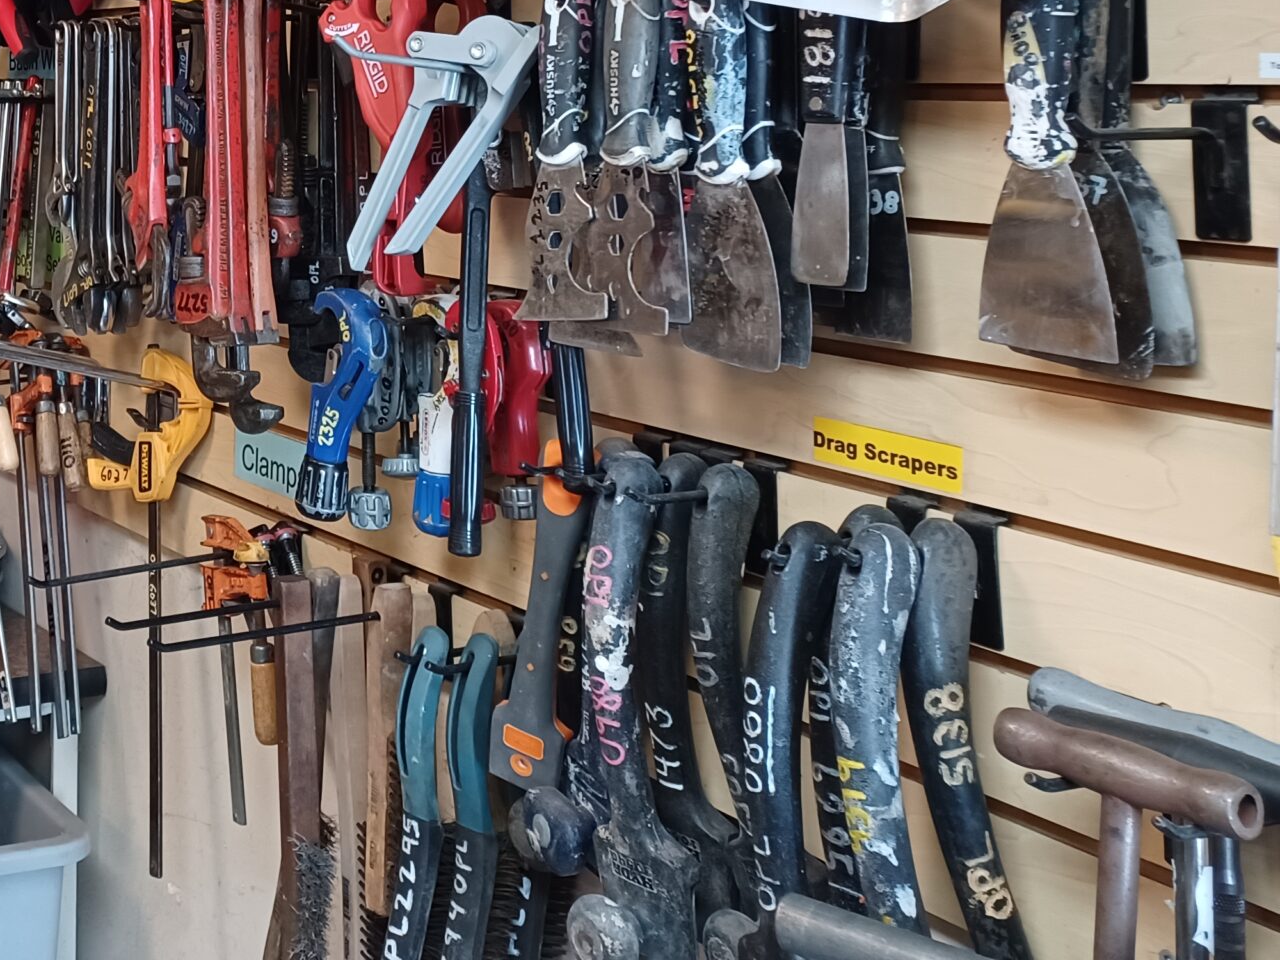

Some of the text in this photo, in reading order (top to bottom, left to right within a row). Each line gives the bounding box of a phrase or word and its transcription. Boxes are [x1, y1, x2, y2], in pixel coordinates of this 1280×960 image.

[328, 22, 352, 32] CUTTER
[544, 54, 555, 99] HUSKY
[610, 49, 620, 97] HUSKY
[340, 310, 350, 342] OPL
[241, 442, 300, 488] Clamp
[813, 431, 959, 482] Drag Scrapers
[644, 702, 685, 791] 1473
[963, 831, 1015, 921] OPL
